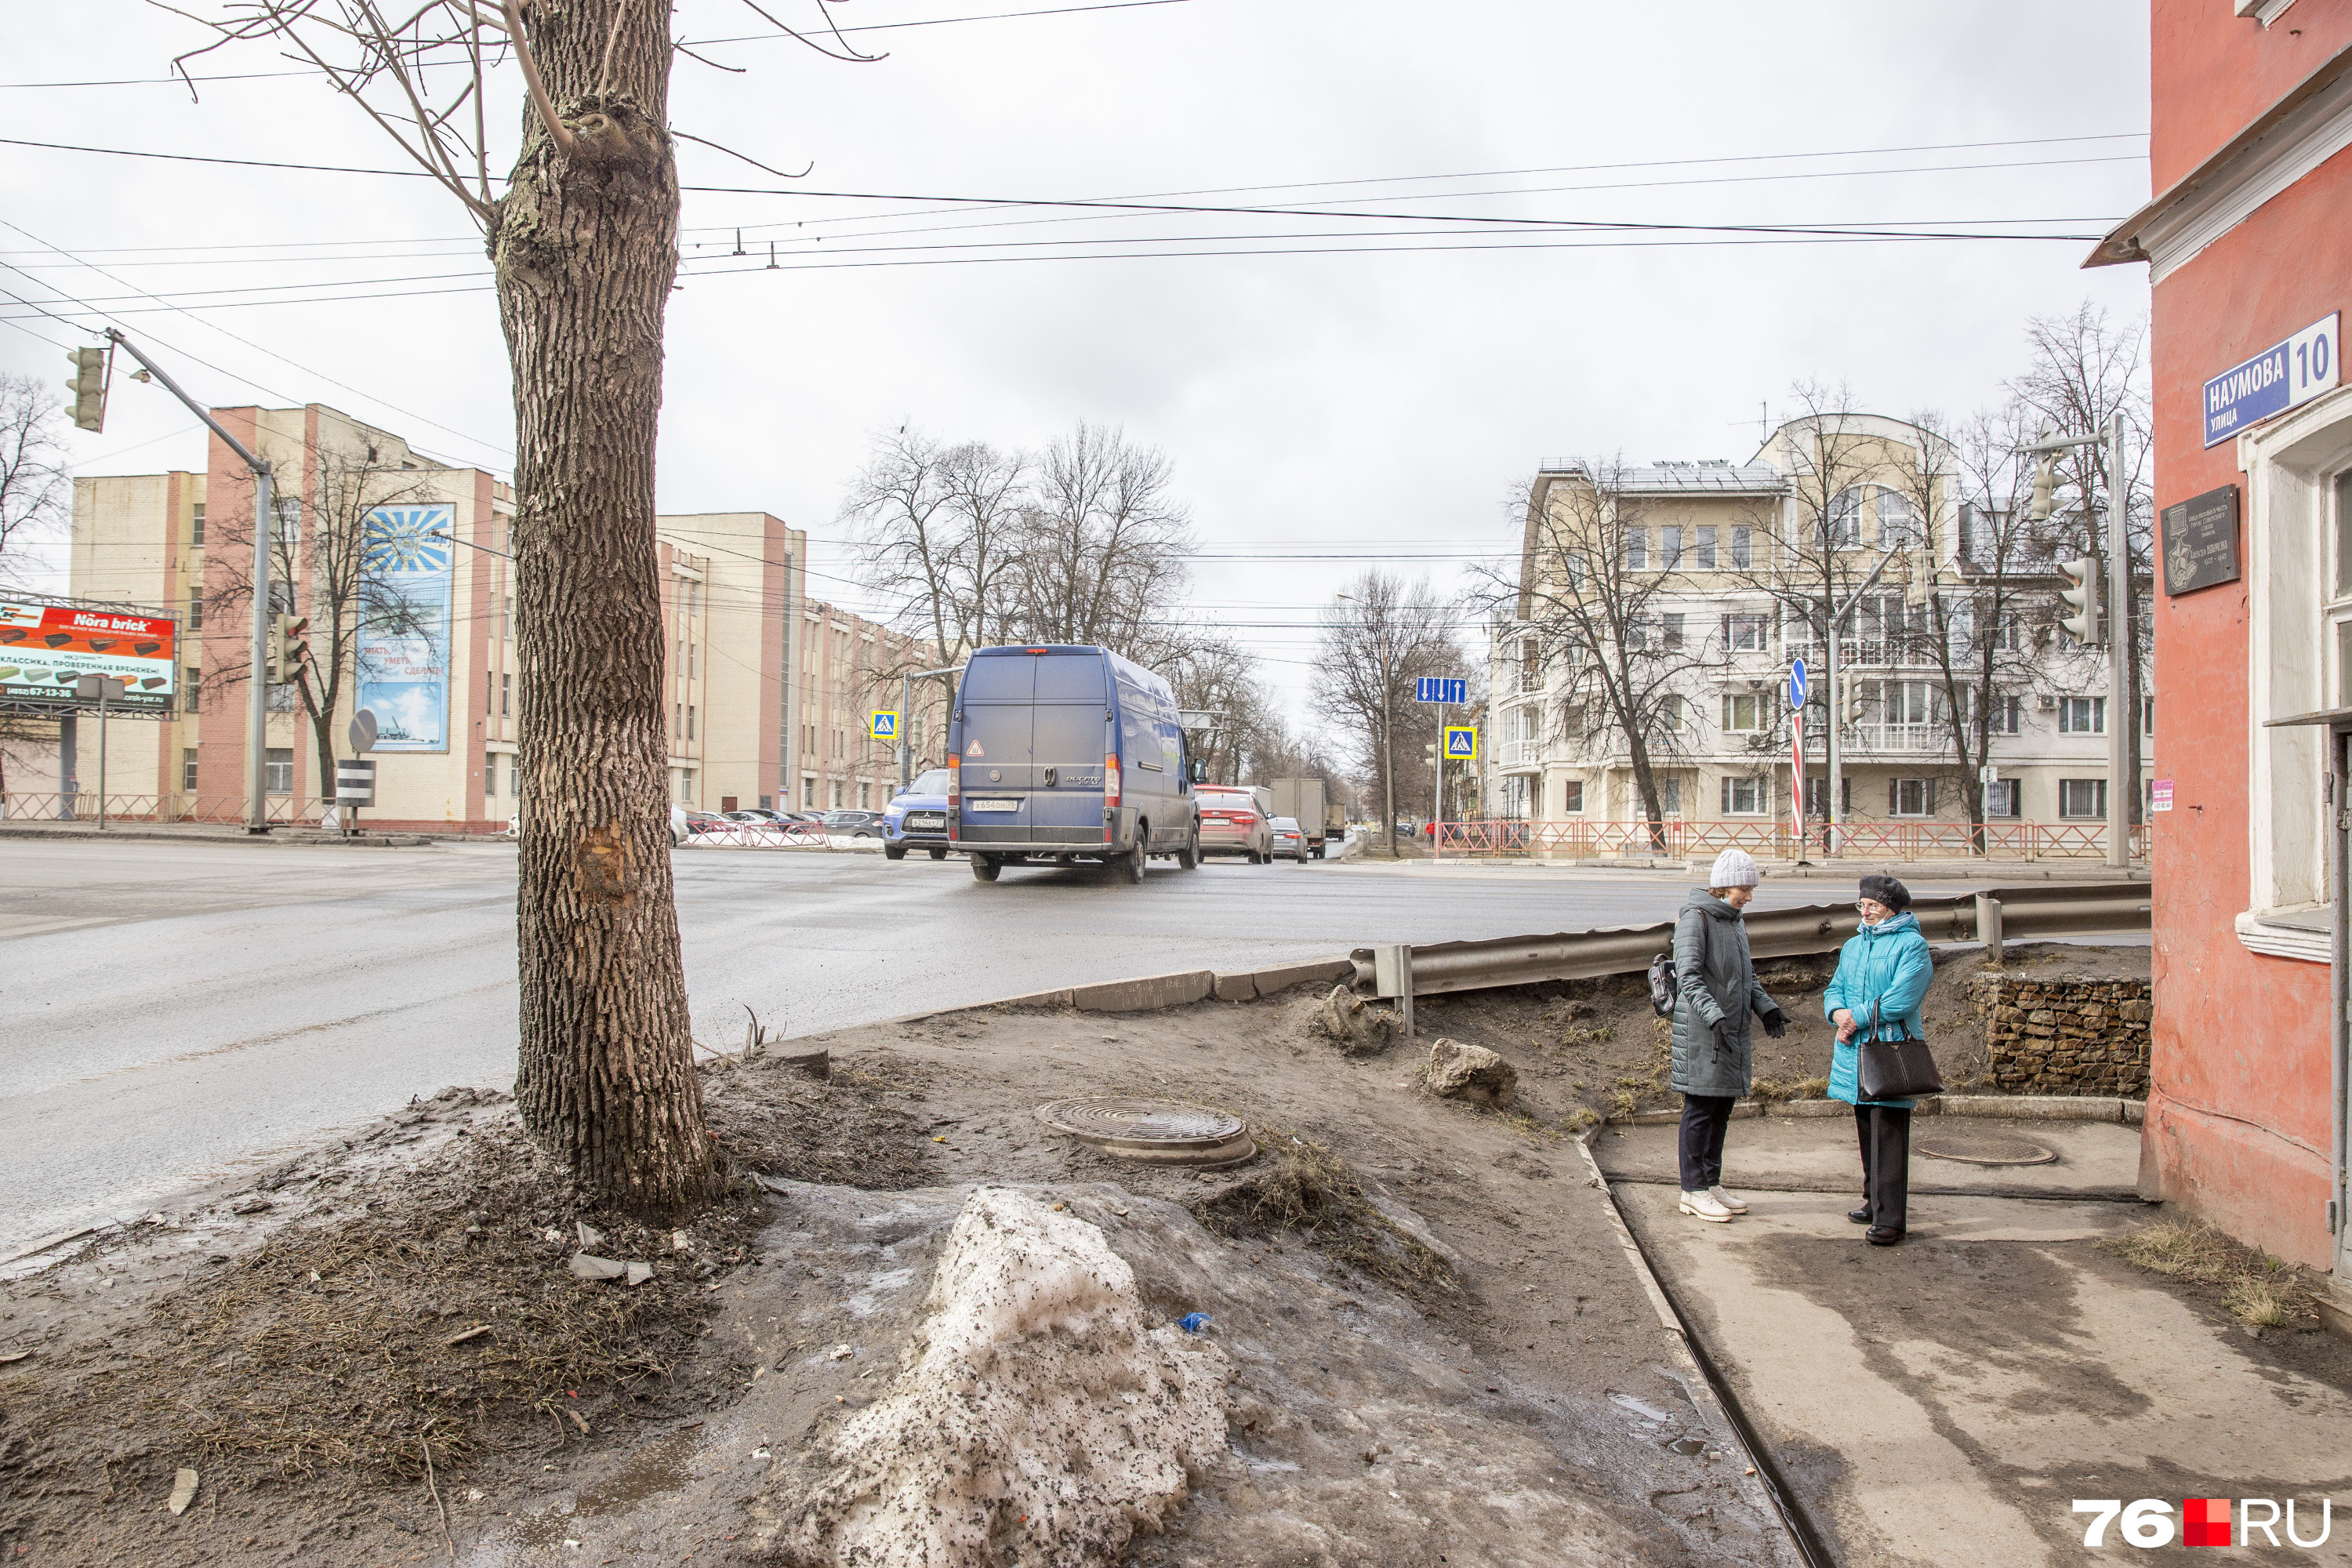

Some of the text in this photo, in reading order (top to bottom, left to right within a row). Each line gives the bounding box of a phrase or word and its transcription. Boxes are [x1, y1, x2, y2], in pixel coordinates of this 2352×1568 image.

[2210, 333, 2329, 413] НАУМОВА 10
[2211, 408, 2238, 434] УЛИЦА
[364, 647, 391, 655] ЗНАТЬ,
[53, 660, 112, 670] ПРОВЕРЕННАЯ
[115, 665, 158, 673] ВРЕМЕНЕМ!
[383, 657, 412, 666] УМЕТЬ,
[29, 688, 72, 698] 67-13-36
